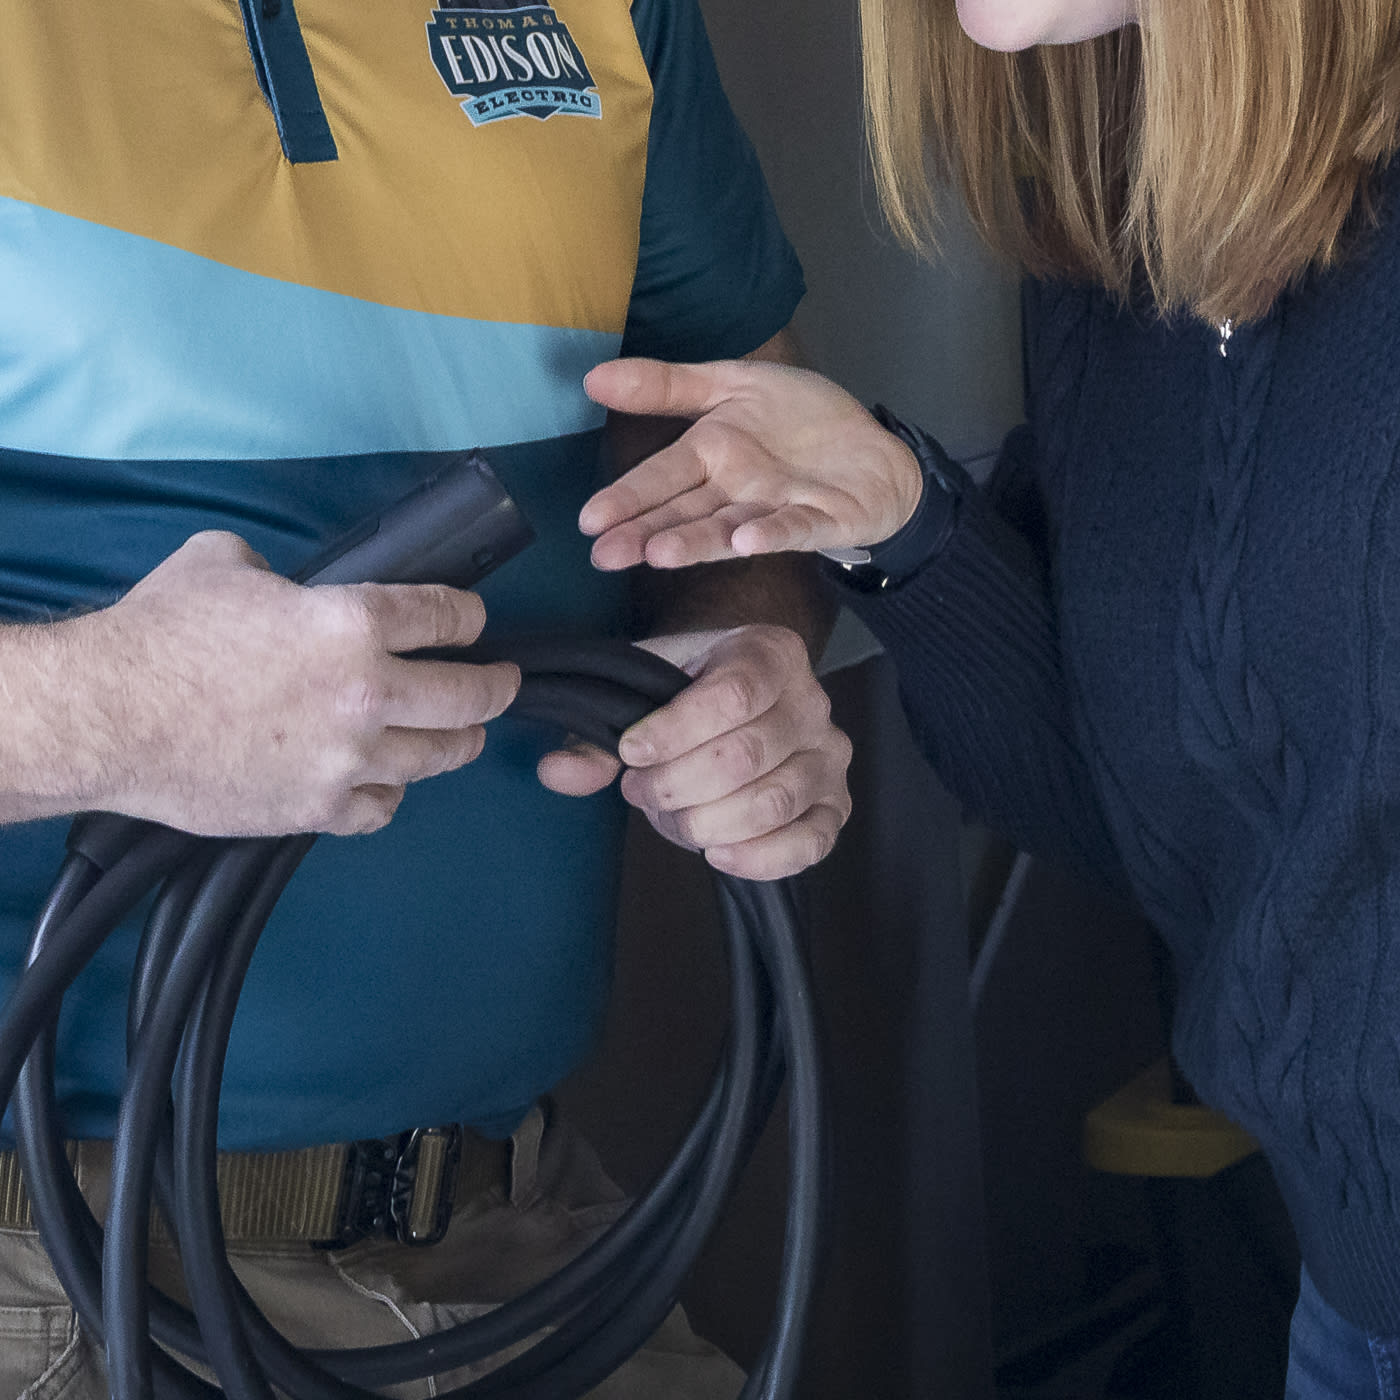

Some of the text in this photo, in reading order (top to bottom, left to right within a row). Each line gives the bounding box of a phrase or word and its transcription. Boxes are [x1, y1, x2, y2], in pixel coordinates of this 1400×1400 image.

[446, 14, 554, 30] THOMAS
[439, 31, 585, 85] EDISON
[473, 89, 593, 115] ELECTRIC
